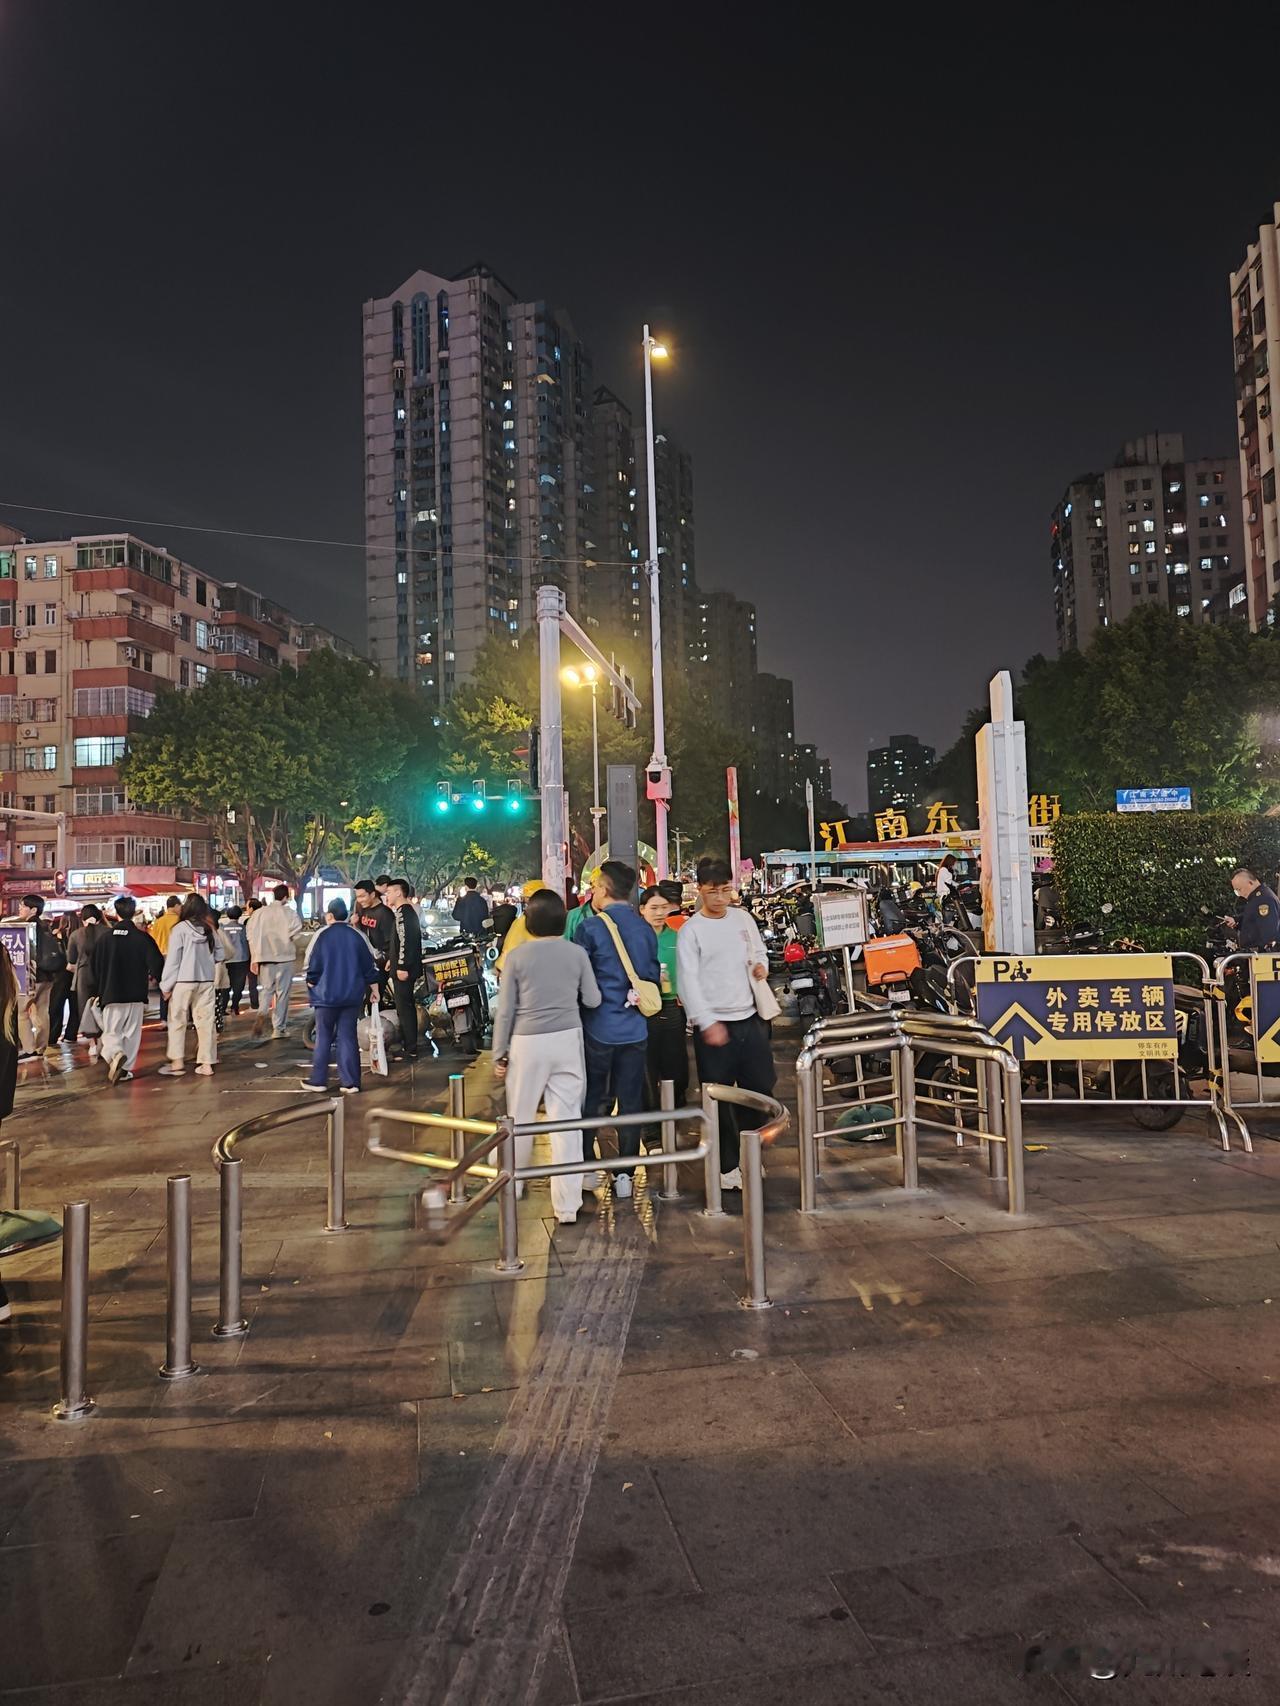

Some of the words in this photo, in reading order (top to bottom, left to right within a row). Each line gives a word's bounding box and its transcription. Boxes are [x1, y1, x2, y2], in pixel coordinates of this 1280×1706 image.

[993, 960, 1010, 982] P
[1046, 985, 1165, 1009] 外卖车辆
[1047, 1010, 1167, 1033] 专用停放区
[1137, 1042, 1168, 1050] 停车有序
